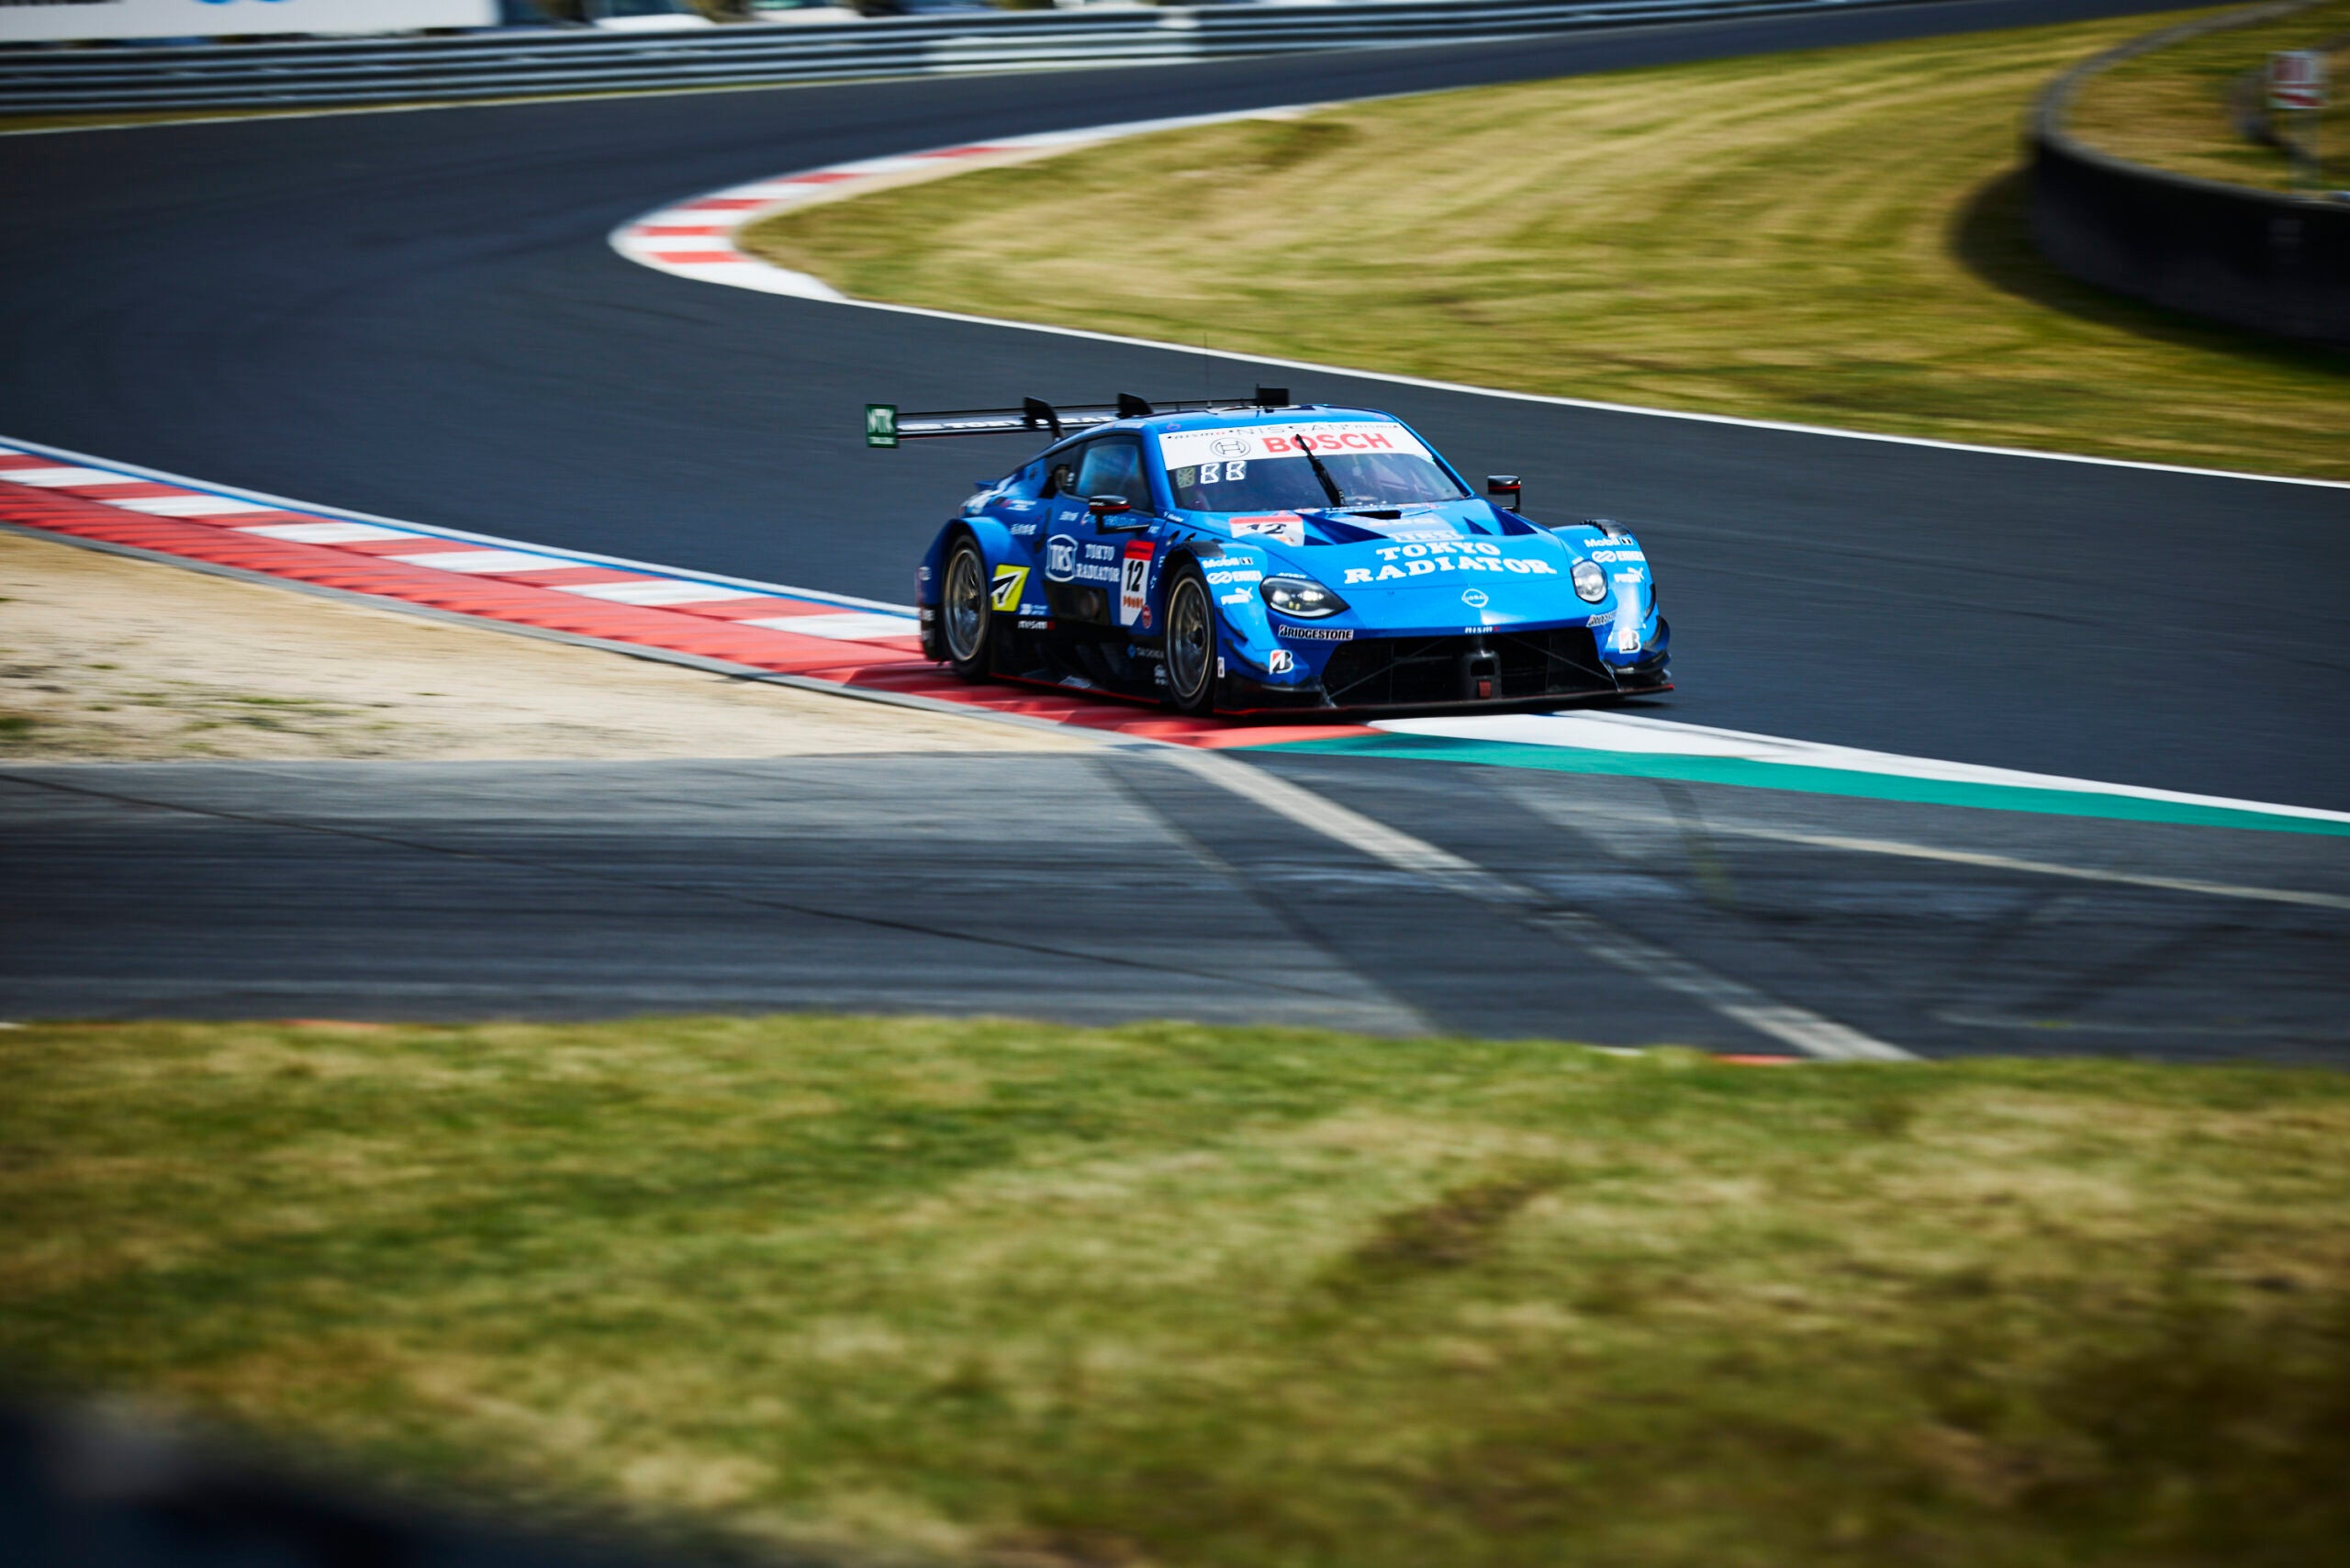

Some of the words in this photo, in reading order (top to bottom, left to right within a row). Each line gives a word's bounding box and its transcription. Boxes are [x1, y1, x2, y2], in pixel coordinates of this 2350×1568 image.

[1261, 432, 1394, 454] BOSCH
[1376, 542, 1502, 561] TOKYO
[1126, 560, 1145, 592] 12
[1344, 555, 1559, 585] RADIATOR
[1279, 624, 1354, 641] BRIDGESTONE
